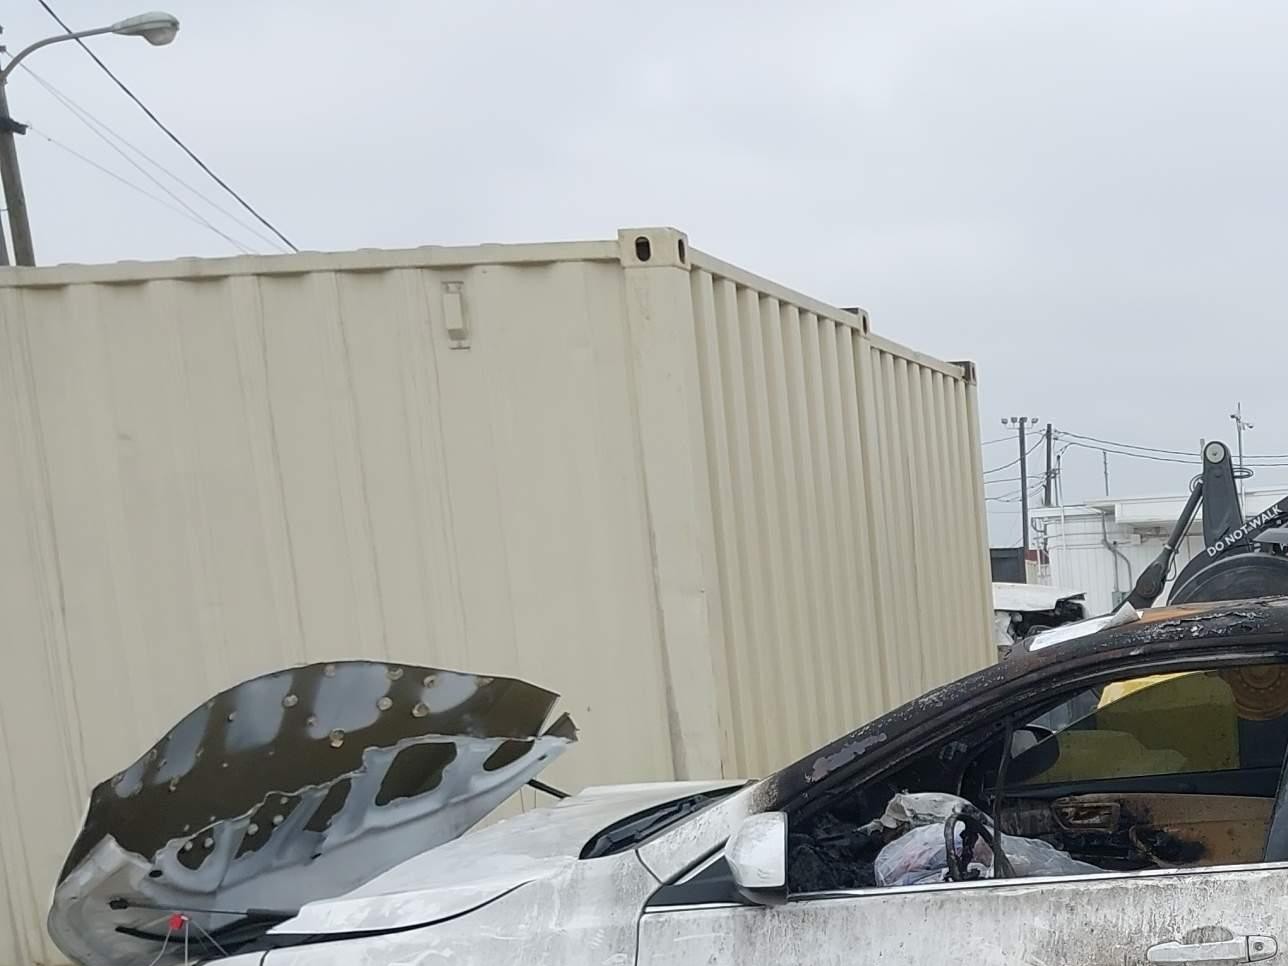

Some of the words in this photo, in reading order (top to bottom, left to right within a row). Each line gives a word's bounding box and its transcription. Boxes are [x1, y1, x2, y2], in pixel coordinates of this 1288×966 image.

[1206, 541, 1225, 557] DO
[1224, 524, 1249, 546] NOT
[1248, 504, 1283, 529] WALK
